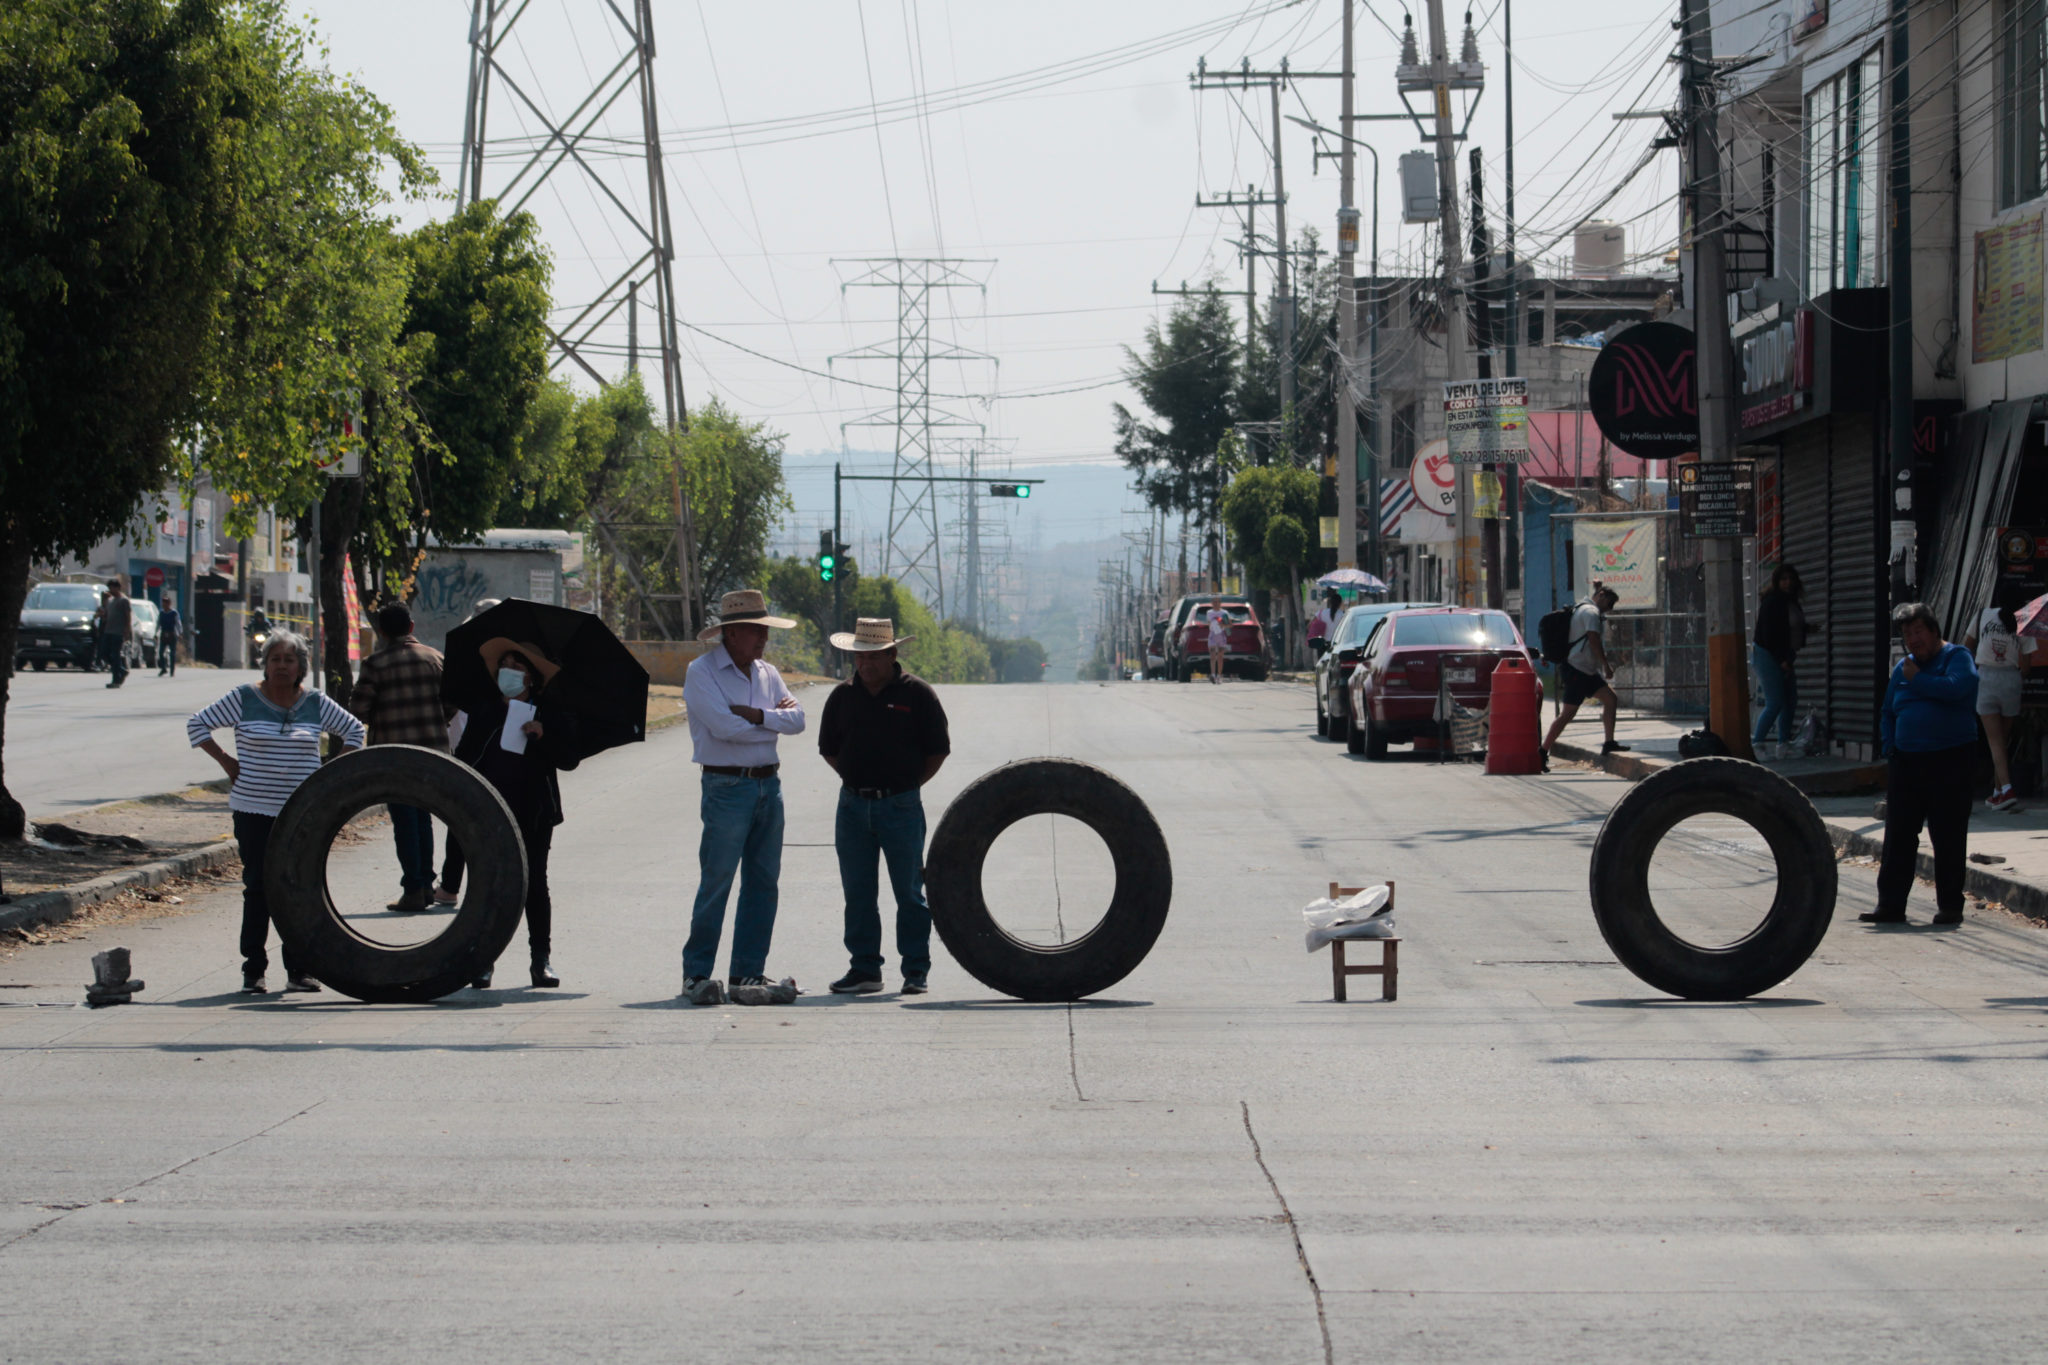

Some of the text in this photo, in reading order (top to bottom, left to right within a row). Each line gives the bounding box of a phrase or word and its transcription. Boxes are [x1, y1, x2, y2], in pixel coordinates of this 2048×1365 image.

[1446, 381, 1526, 398] VENTA DE LOTES
[1450, 397, 1523, 409] CON O SIN ENGANCHE
[1448, 413, 1456, 421] EN
[1458, 411, 1473, 420] ESTA
[1619, 432, 1697, 443] by Melissa Verdugo
[1462, 450, 1474, 462] 22
[1477, 450, 1488, 462] 28
[1491, 449, 1501, 461] 15
[1504, 449, 1515, 461] 76
[1518, 449, 1527, 461] 11
[1702, 474, 1731, 482] TAQUIZAS
[1681, 483, 1719, 492] BANQUETES
[1725, 481, 1752, 490] TIEMPOS
[1699, 493, 1712, 501] BOX
